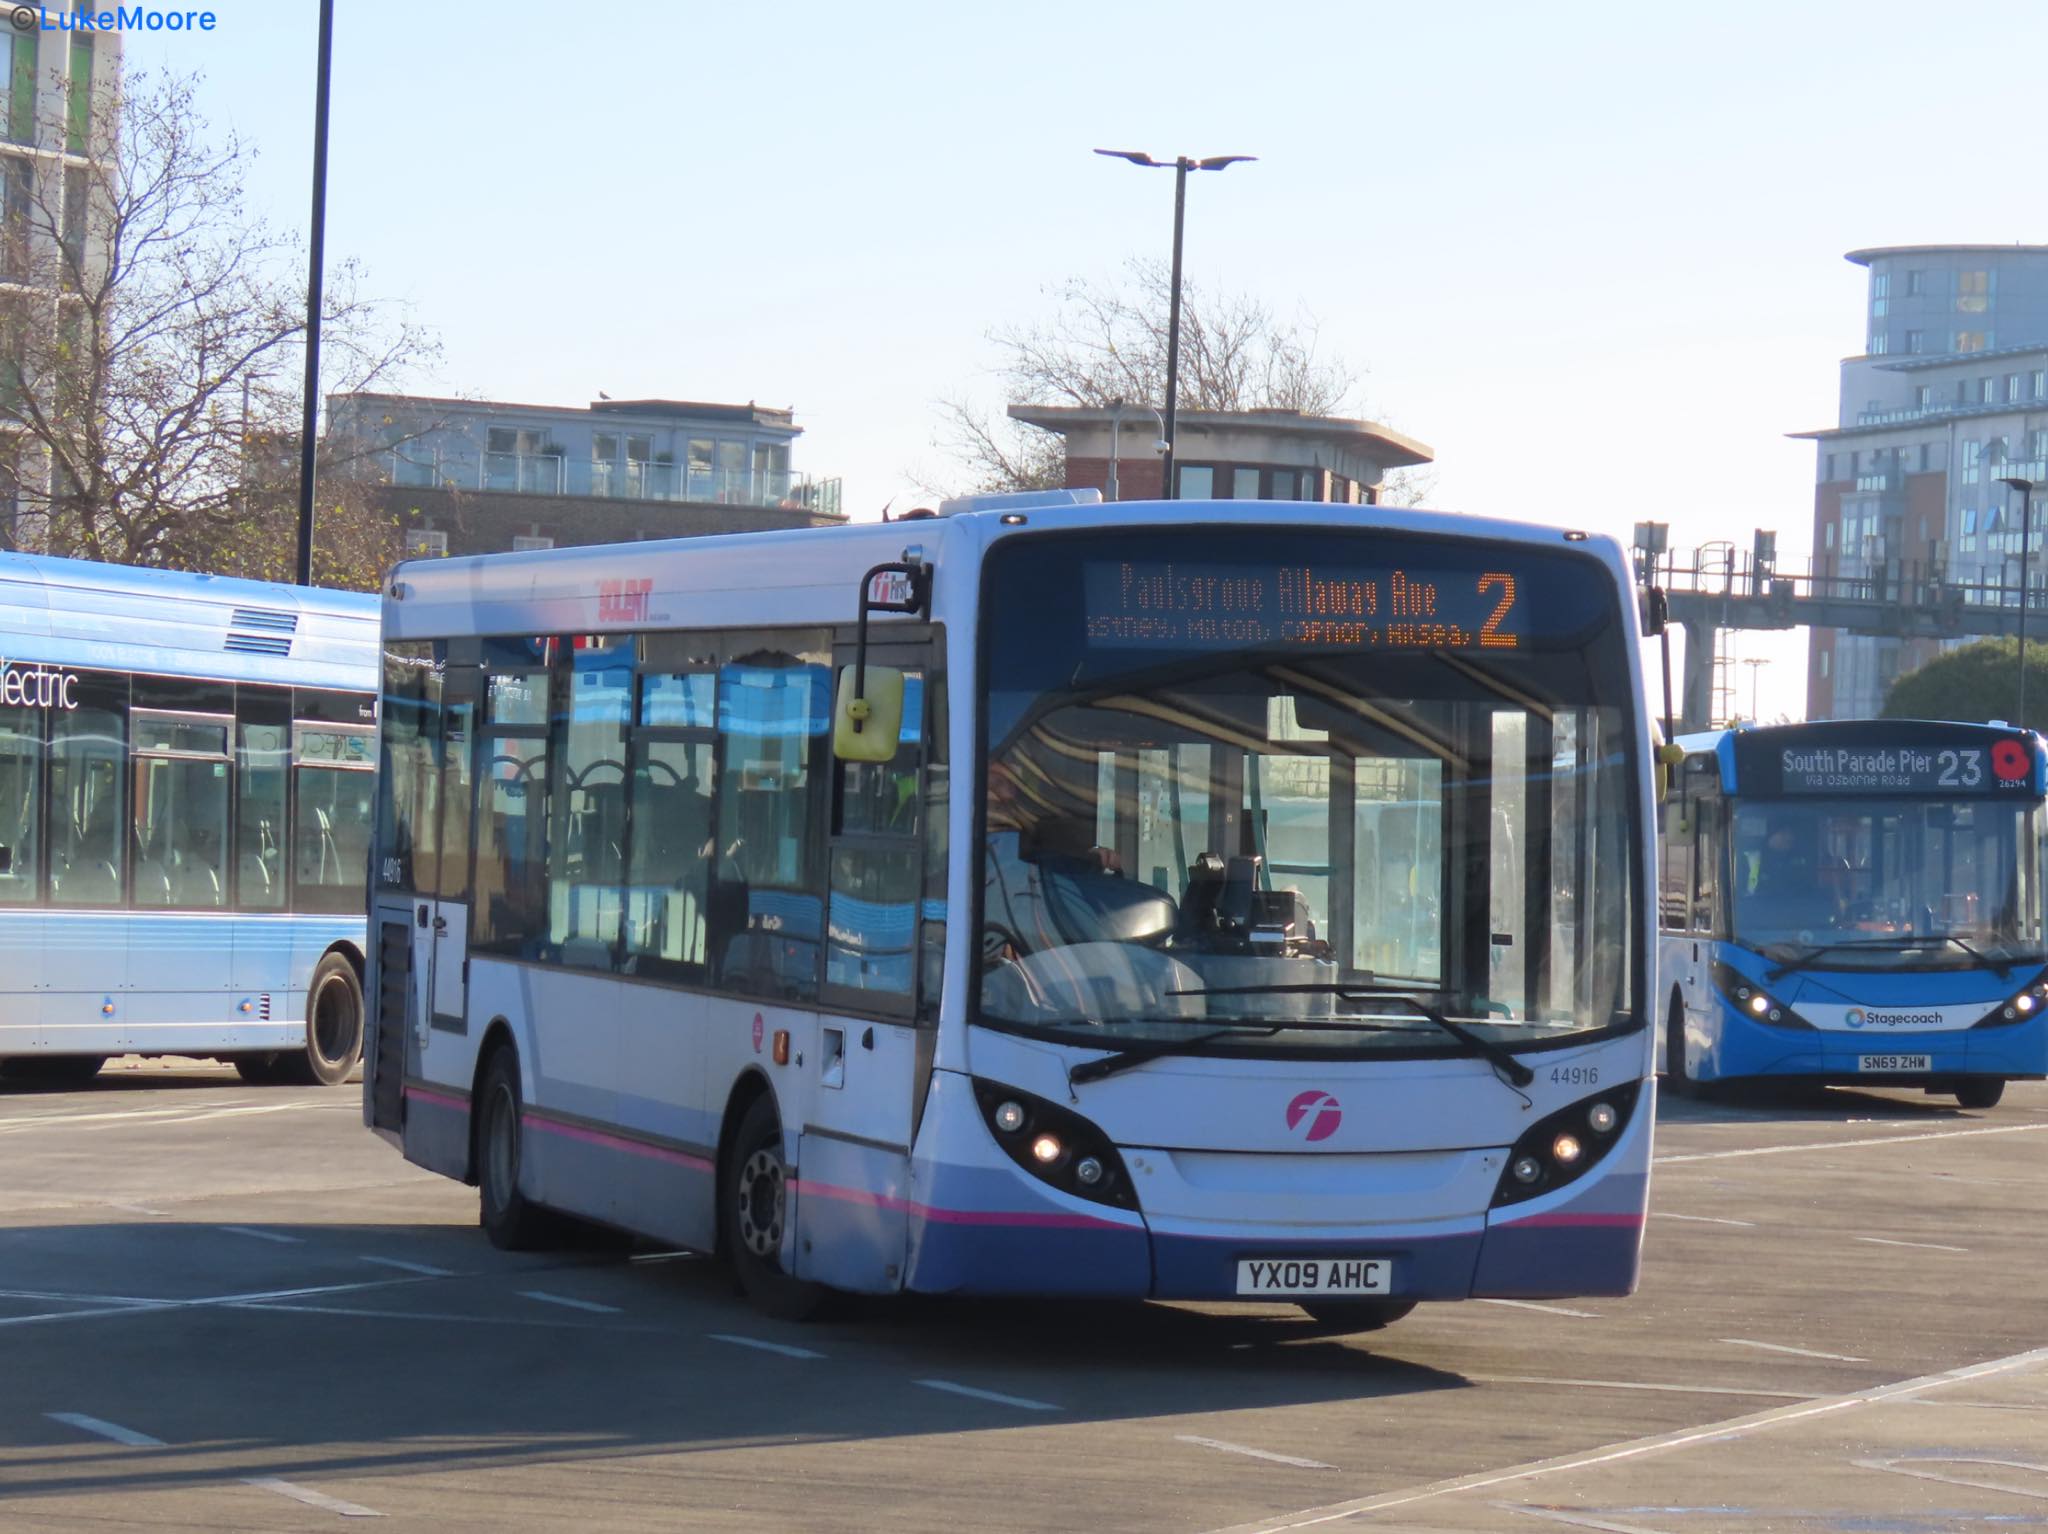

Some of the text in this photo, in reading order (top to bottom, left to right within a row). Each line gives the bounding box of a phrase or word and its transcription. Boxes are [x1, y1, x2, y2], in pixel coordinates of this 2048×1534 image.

[1121, 563, 1437, 616] Paulsgrove Allaway Ave
[1477, 571, 1518, 647] 2
[1388, 623, 1471, 646] Hilsea,
[0, 656, 79, 710] lectric
[1783, 749, 1932, 773] South Parade Pier
[1936, 750, 1982, 787] 23
[1866, 1011, 1943, 1027] Stagecoach
[1863, 1056, 1926, 1070] SN69 ZHW
[1549, 1066, 1600, 1086] 44916
[1248, 1262, 1381, 1289] YX09 AHC
